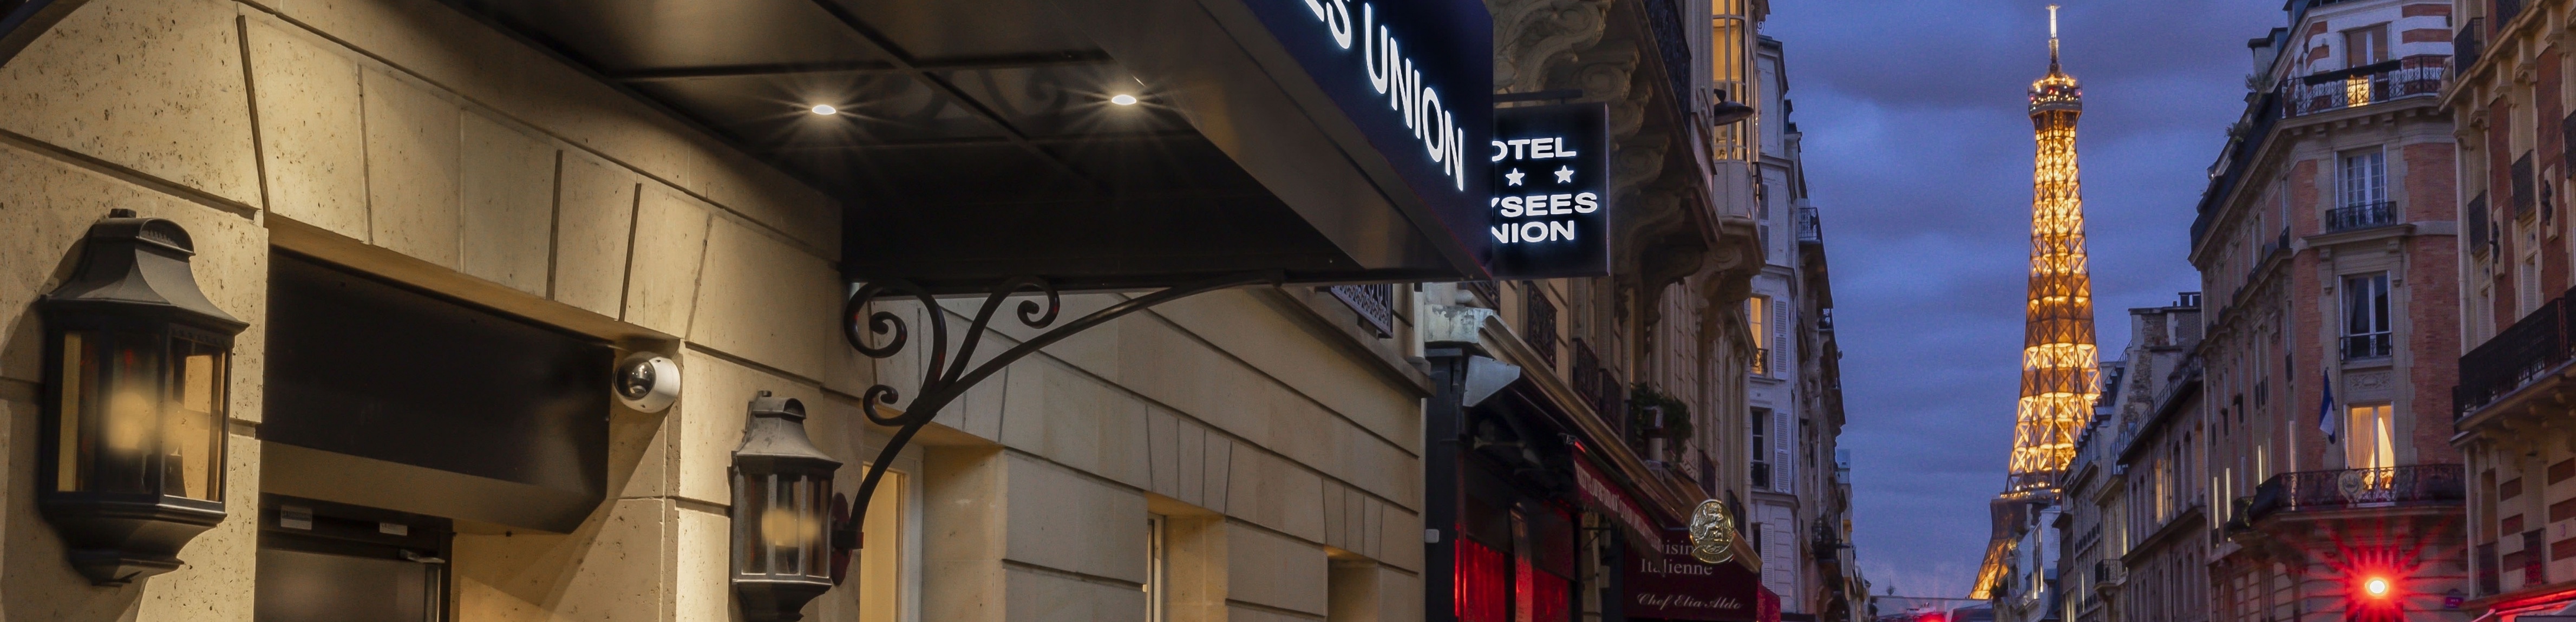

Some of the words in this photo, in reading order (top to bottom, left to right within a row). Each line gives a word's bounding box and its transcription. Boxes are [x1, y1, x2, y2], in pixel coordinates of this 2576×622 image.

[1305, 0, 1352, 49] S
[1365, 2, 1463, 191] UNION
[1491, 192, 1598, 218] SEES
[1491, 220, 1574, 244] NION
[1637, 593, 1673, 611] Chef
[1673, 594, 1703, 607] Elia
[1704, 597, 1744, 610] Aldo
